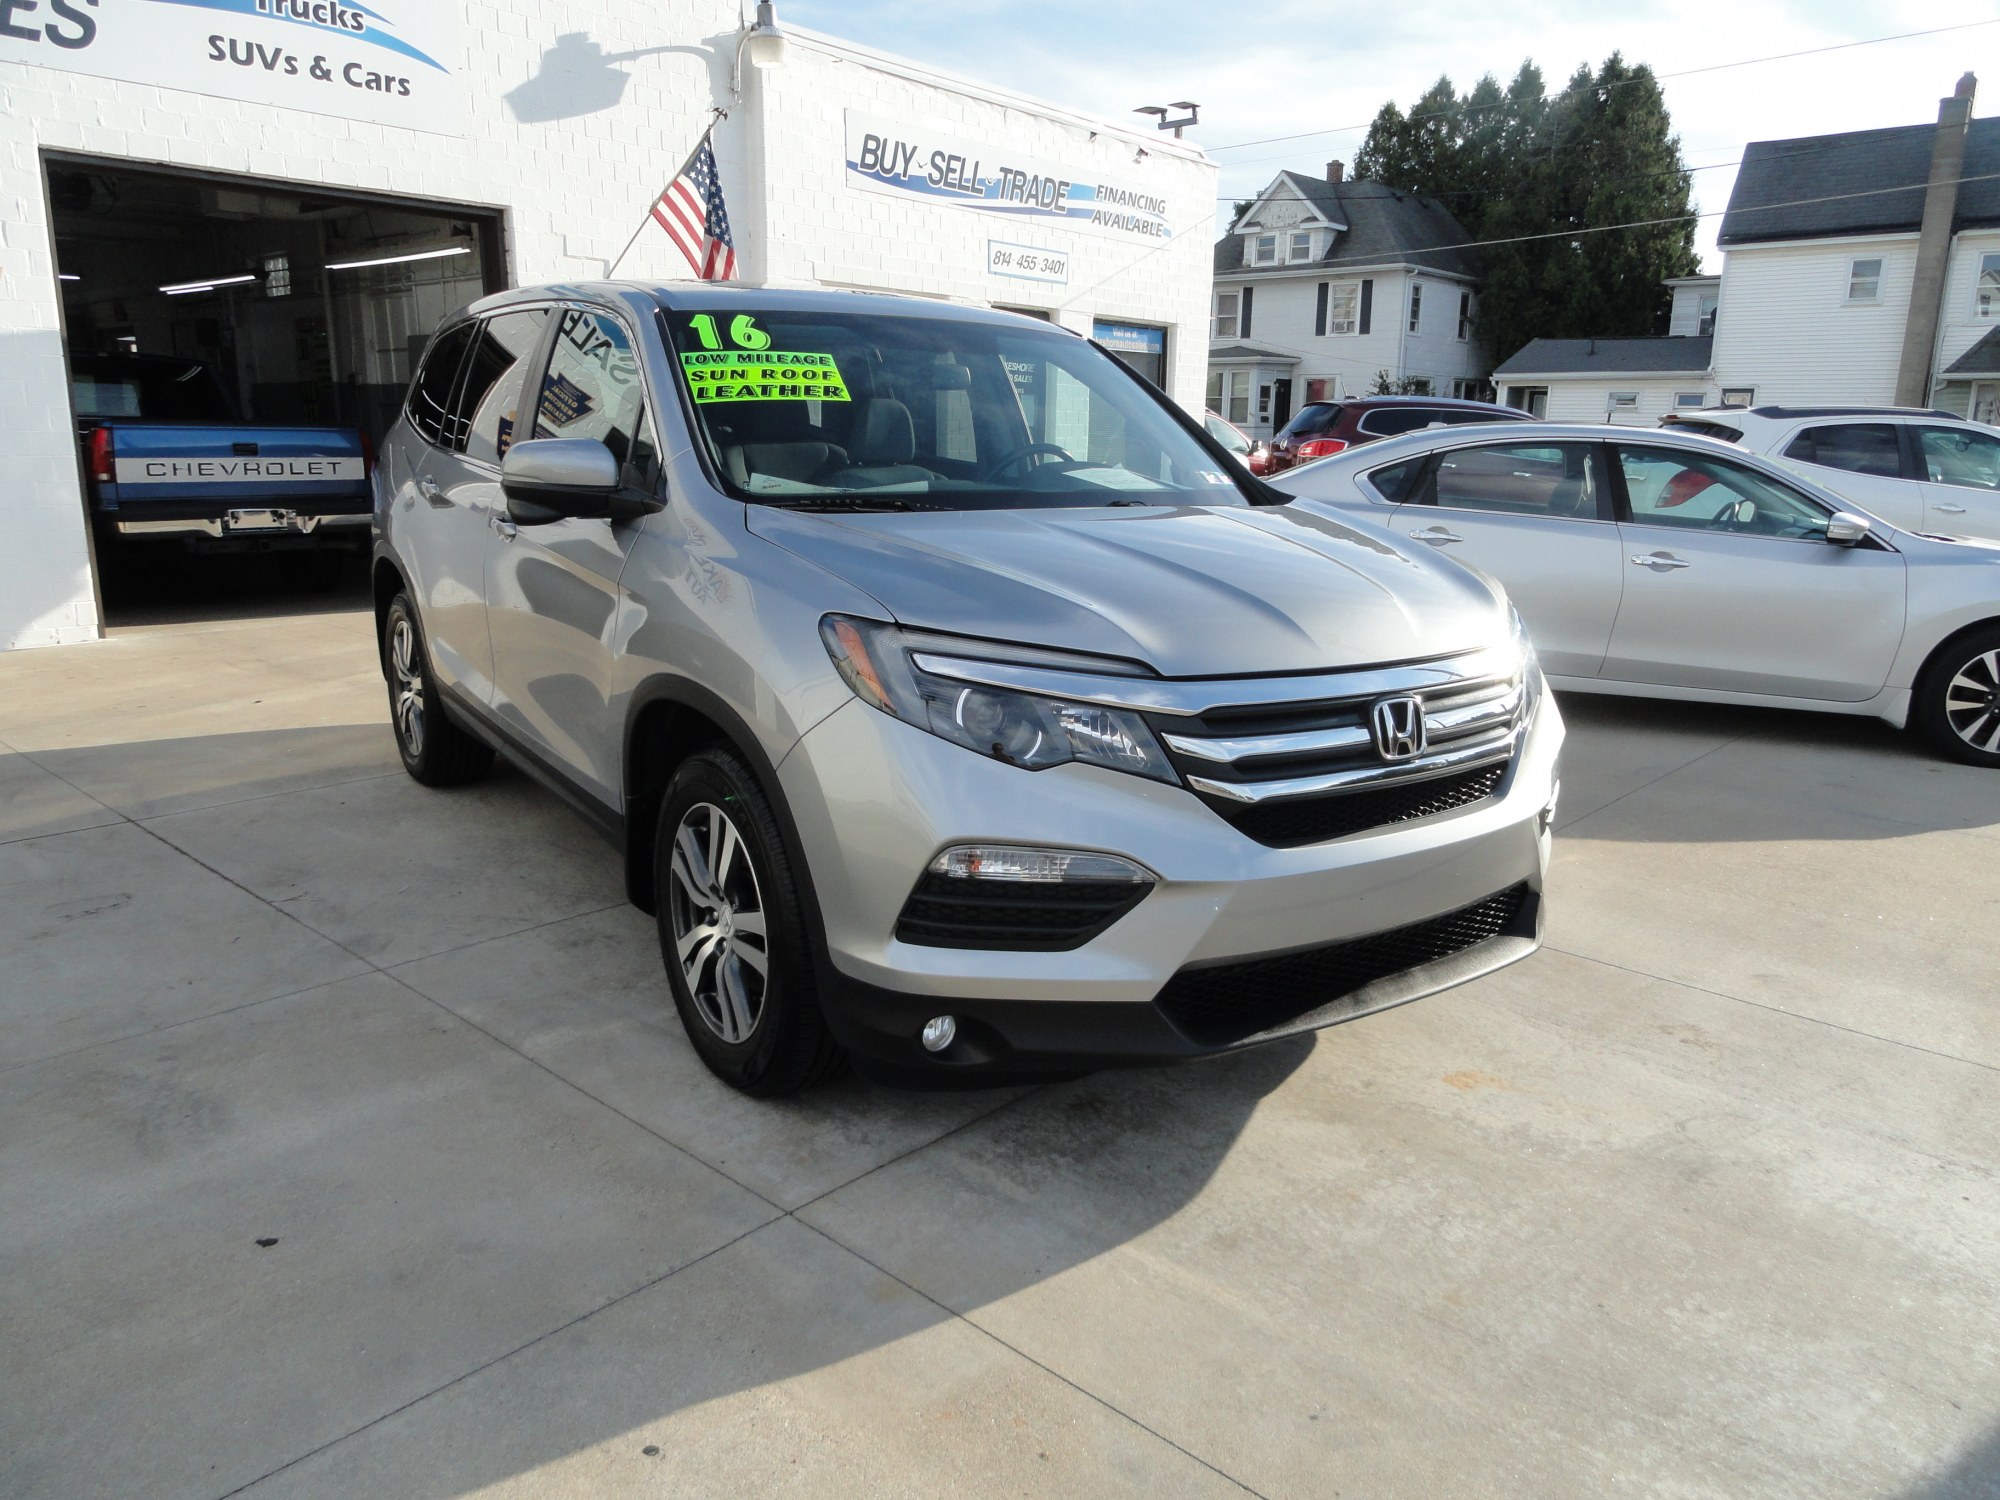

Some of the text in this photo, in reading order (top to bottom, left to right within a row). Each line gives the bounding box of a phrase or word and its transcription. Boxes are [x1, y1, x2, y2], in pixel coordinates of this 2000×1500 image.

[208, 34, 411, 97] SUVs & Cars
[859, 133, 1071, 212] BUY SELL TRADE
[1095, 184, 1167, 215] FINANCING
[1090, 209, 1164, 238] AVAILABLE
[689, 314, 772, 350] 16
[684, 353, 833, 367] LOW MILEAGE
[691, 369, 836, 382] SUN ROOF
[696, 384, 844, 400] LEATHER
[145, 461, 342, 477] CHEVROLET
